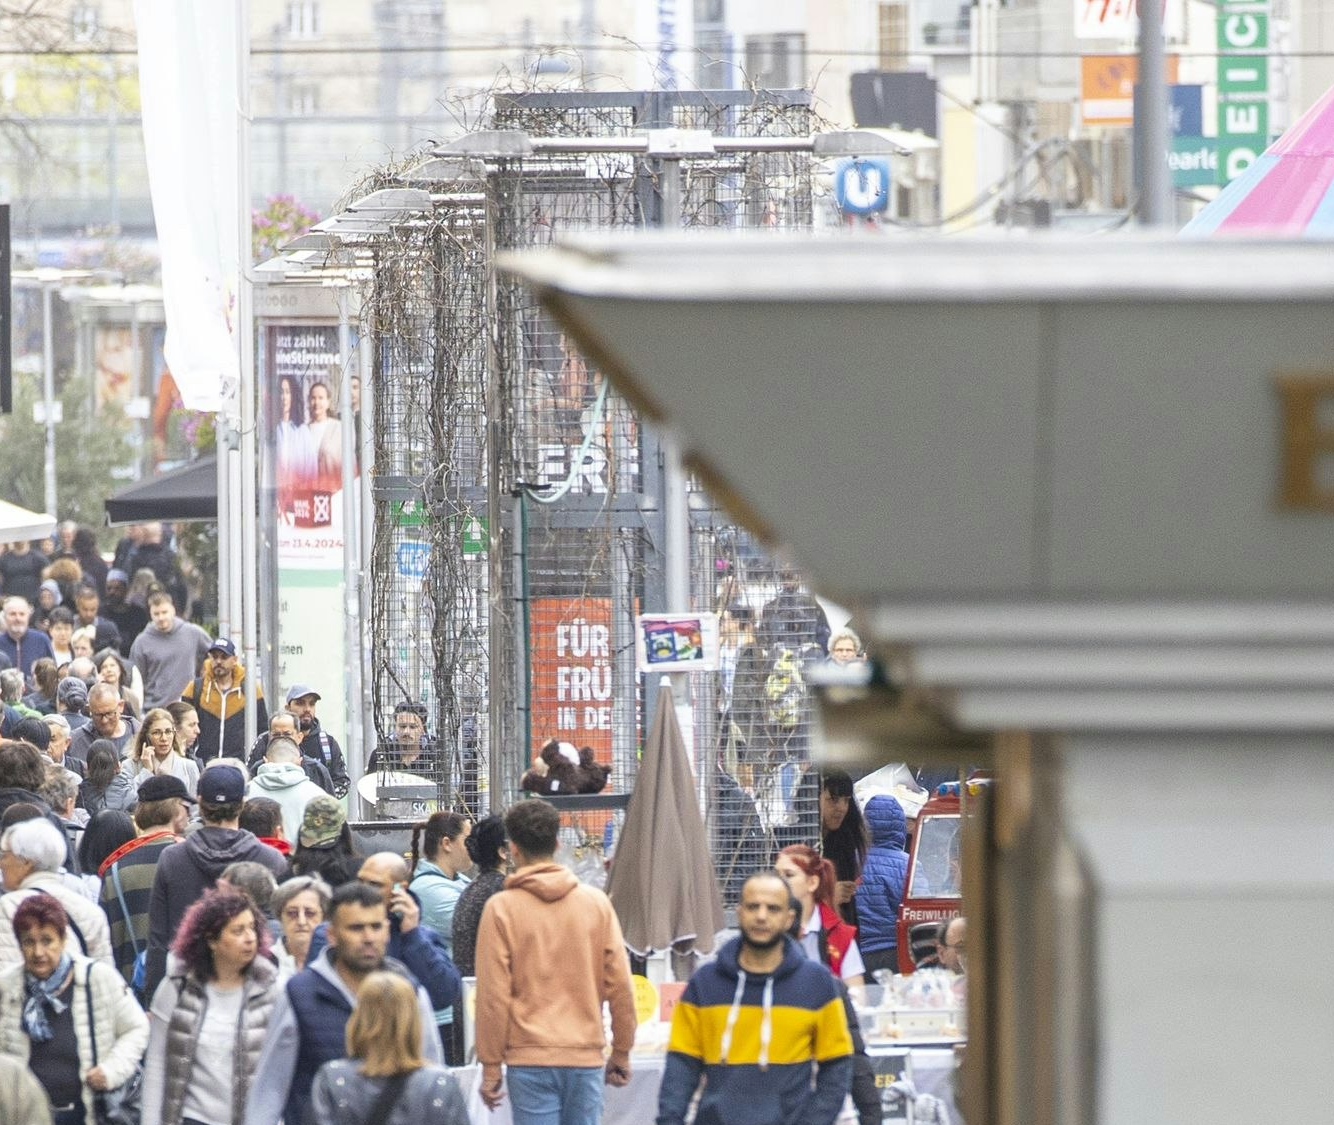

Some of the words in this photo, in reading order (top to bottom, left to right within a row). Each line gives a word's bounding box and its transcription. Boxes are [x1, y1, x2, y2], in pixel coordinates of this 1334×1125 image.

[1224, 0, 1259, 181] DEIC
[845, 167, 881, 208] U
[556, 658, 612, 702] FRÜ
[584, 706, 613, 730] DE
